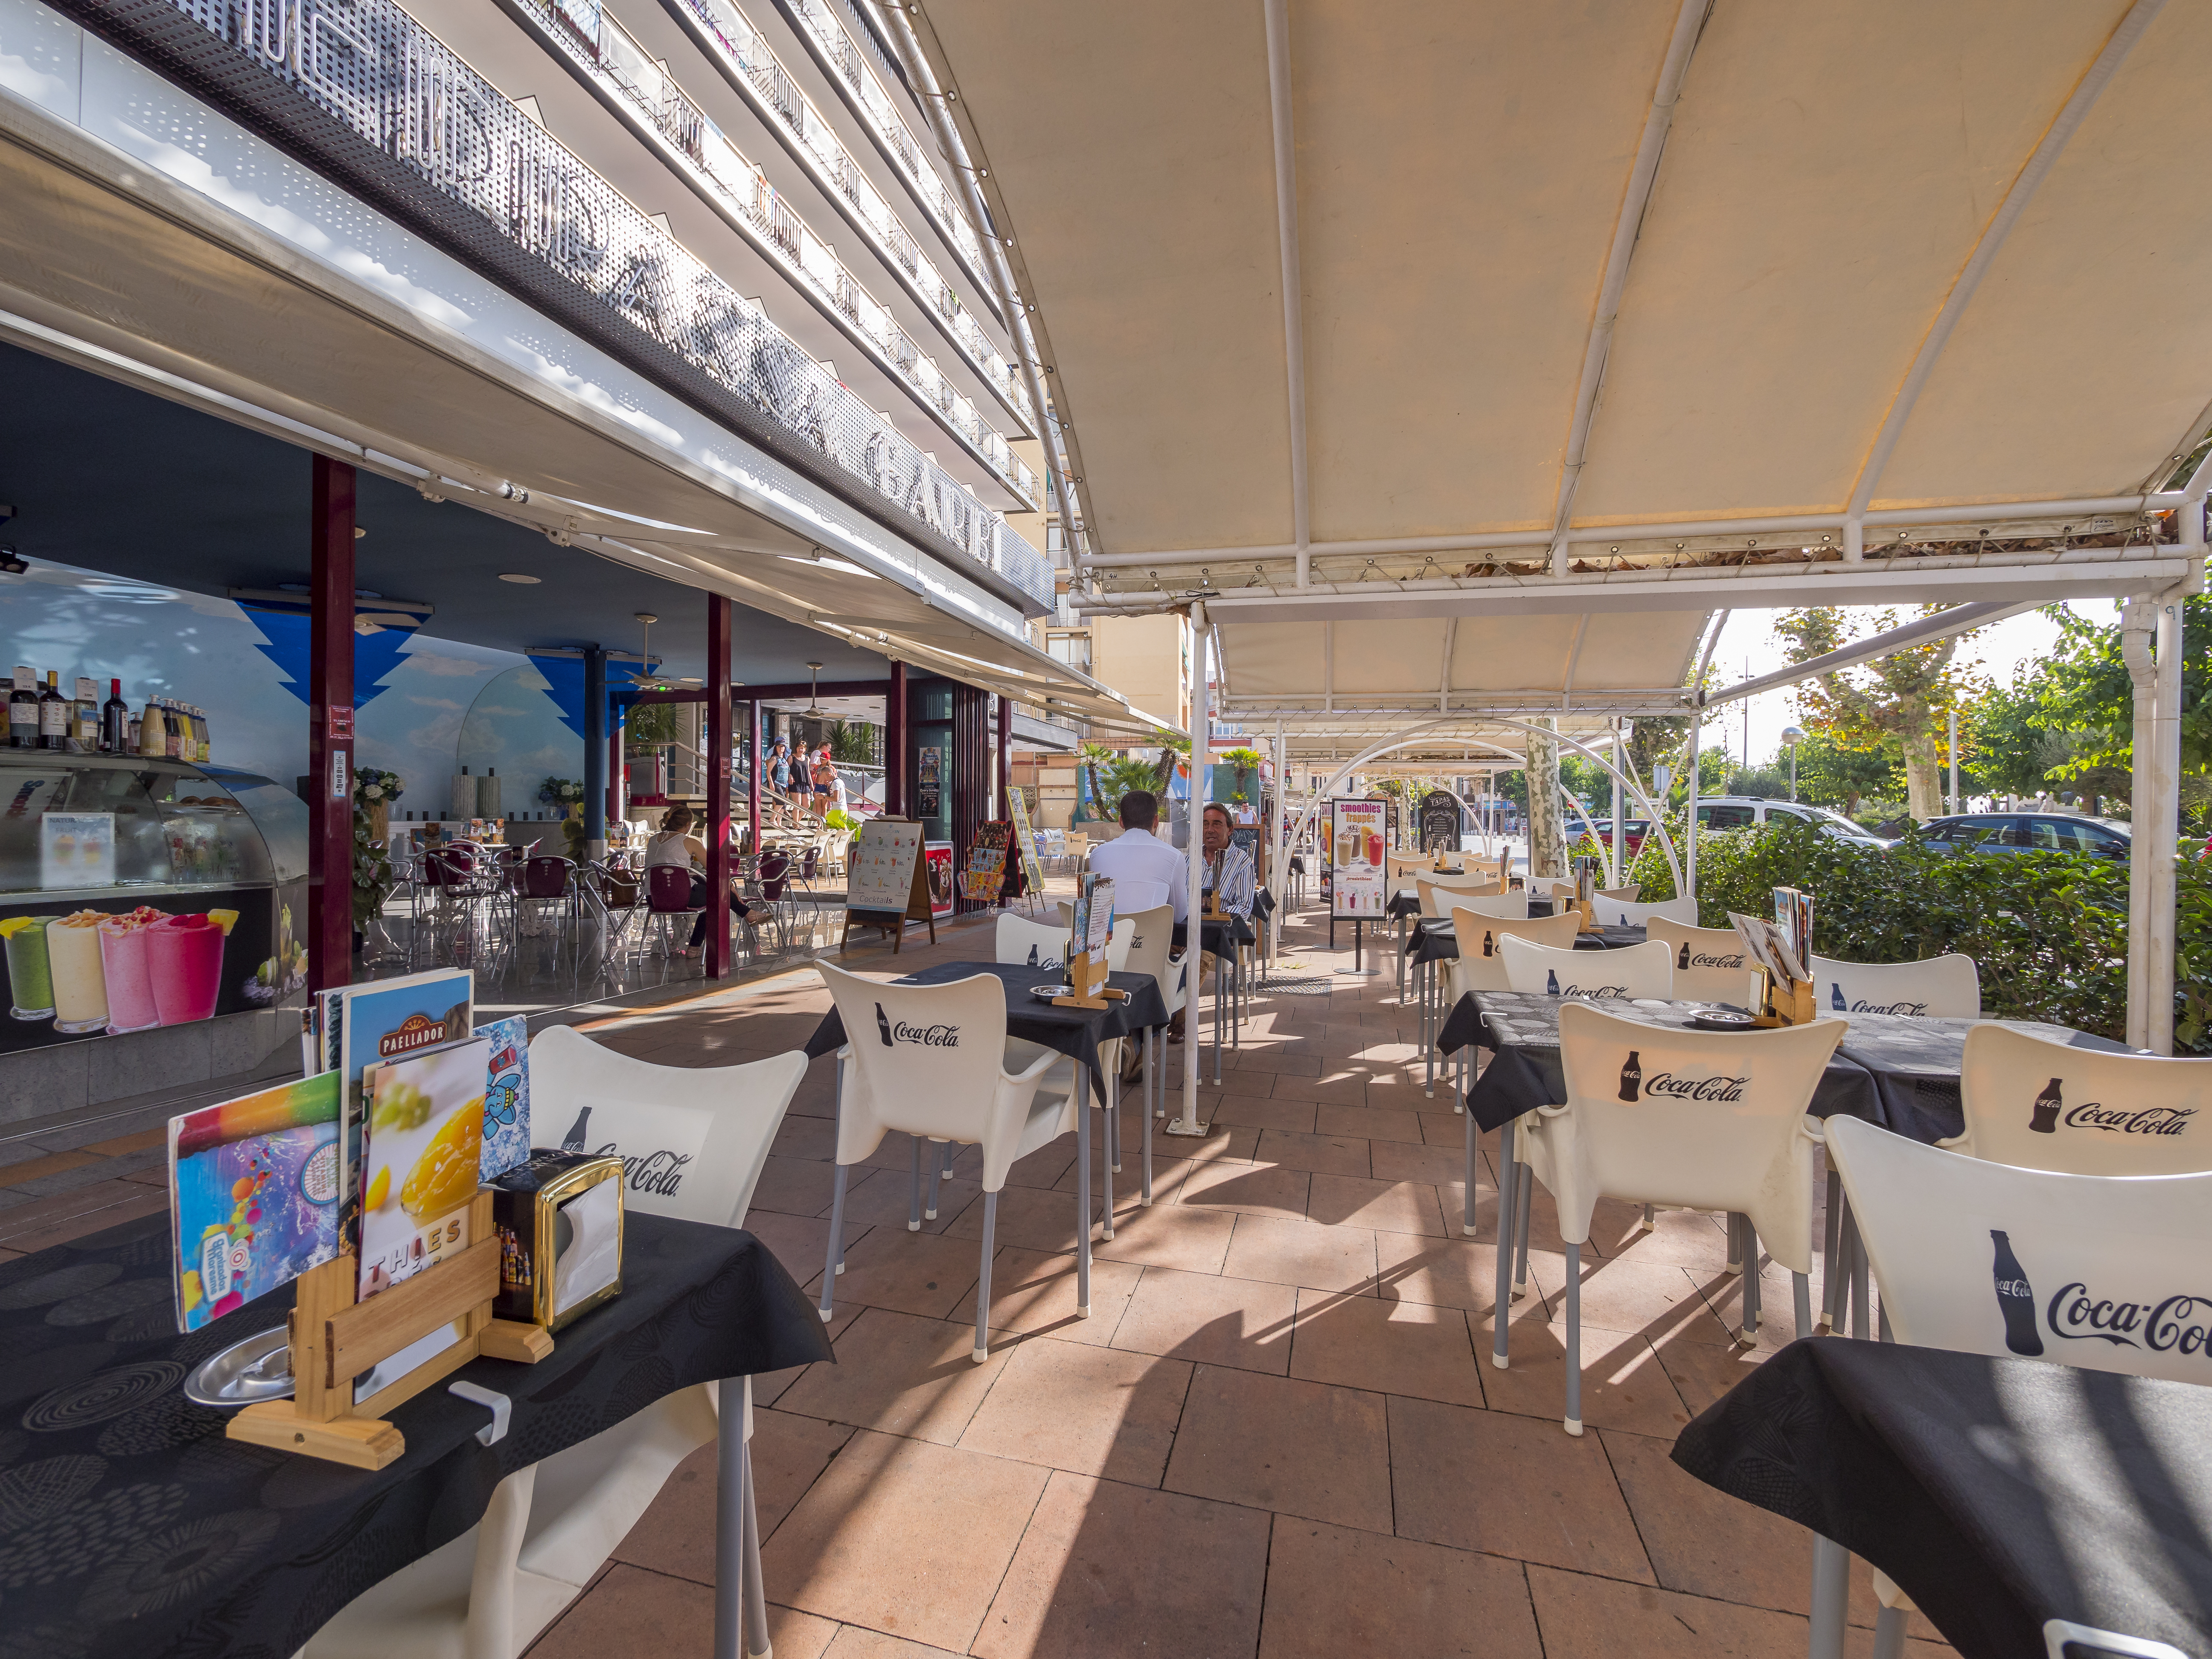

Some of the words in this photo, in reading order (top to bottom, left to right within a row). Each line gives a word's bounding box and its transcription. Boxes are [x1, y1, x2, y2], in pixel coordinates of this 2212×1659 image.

[1340, 803, 1381, 813] smoothies
[1430, 797, 1450, 806] TAPAS
[1346, 813, 1376, 824] frappés
[859, 895, 893, 904] Cocktails
[1691, 953, 1747, 968] Coca-Cola
[384, 1026, 444, 1053] PAELLADOR
[894, 1021, 961, 1047] Coca-Cola
[1644, 1073, 1752, 1102] Coca-Cola
[2064, 1103, 2200, 1136] Coca-Cola
[594, 1143, 694, 1197] a-Cola
[2047, 1282, 2212, 1358] Coca-Co
